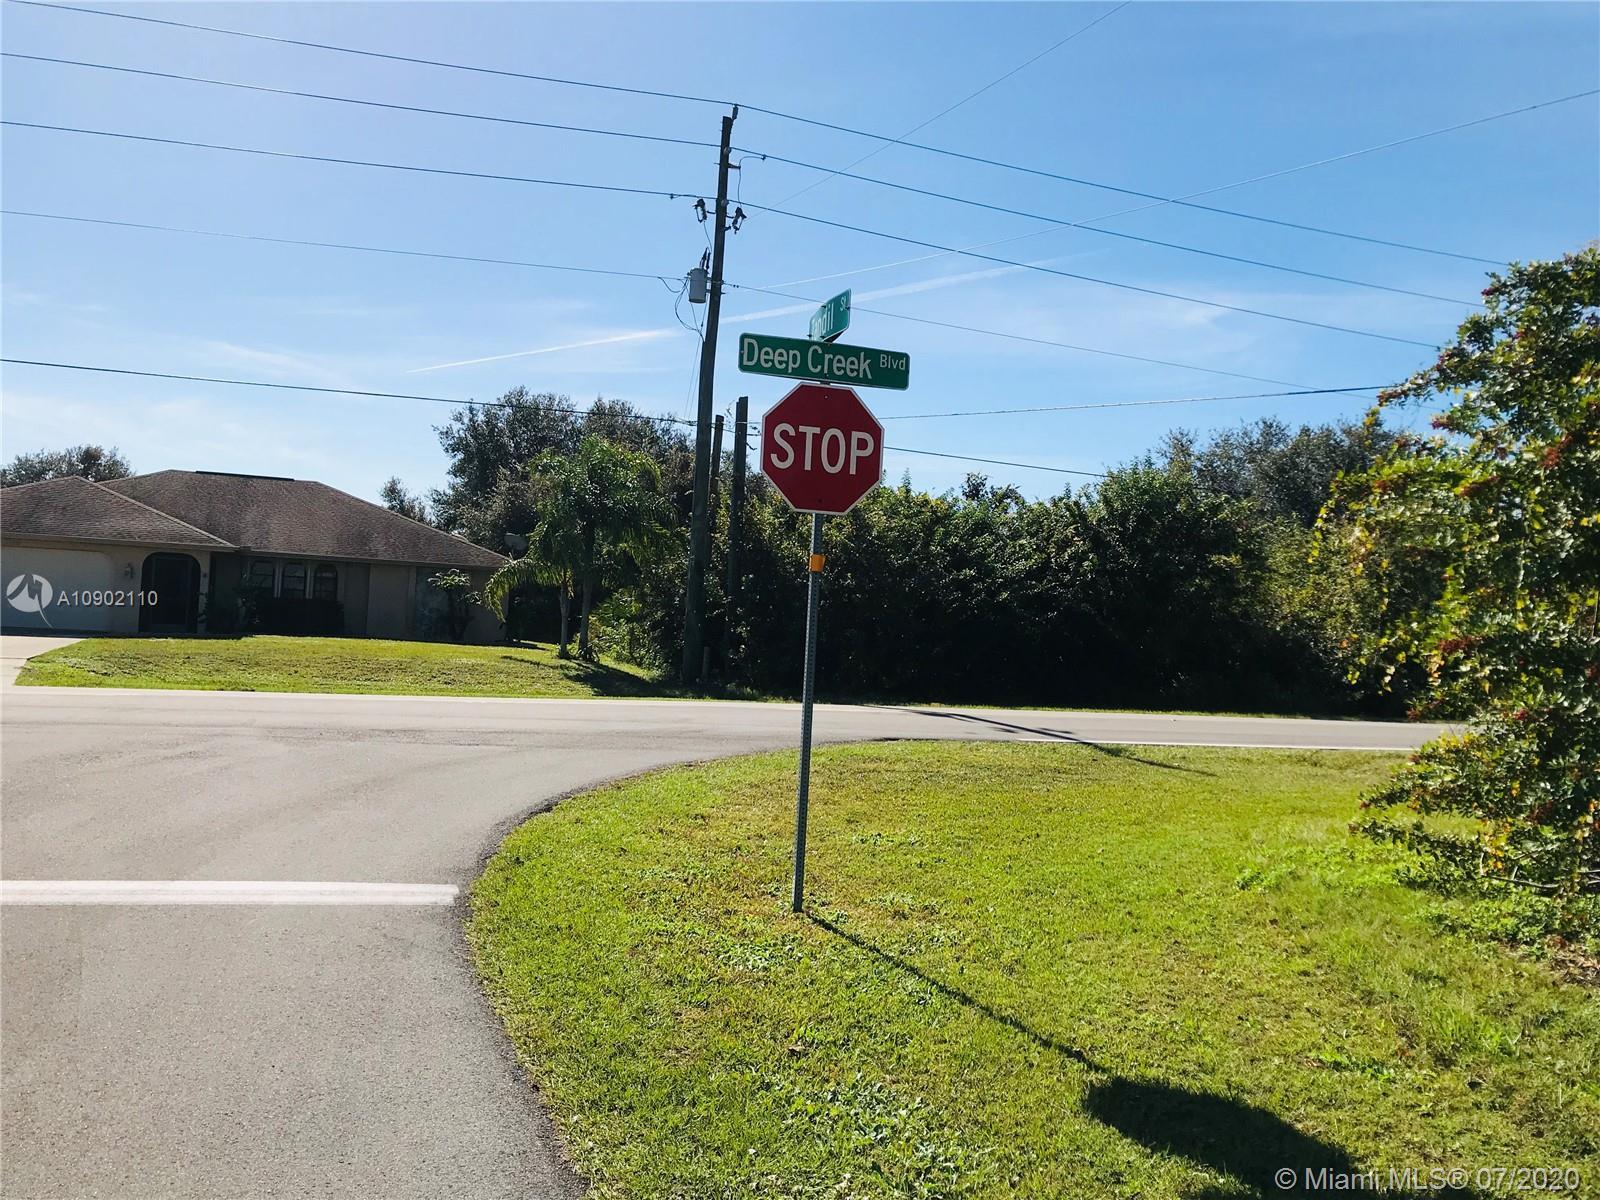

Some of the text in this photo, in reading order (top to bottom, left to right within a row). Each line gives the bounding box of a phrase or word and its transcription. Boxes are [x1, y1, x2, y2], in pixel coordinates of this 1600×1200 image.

[742, 337, 906, 379] Deep Creek Blvd
[770, 422, 875, 475] STOP
